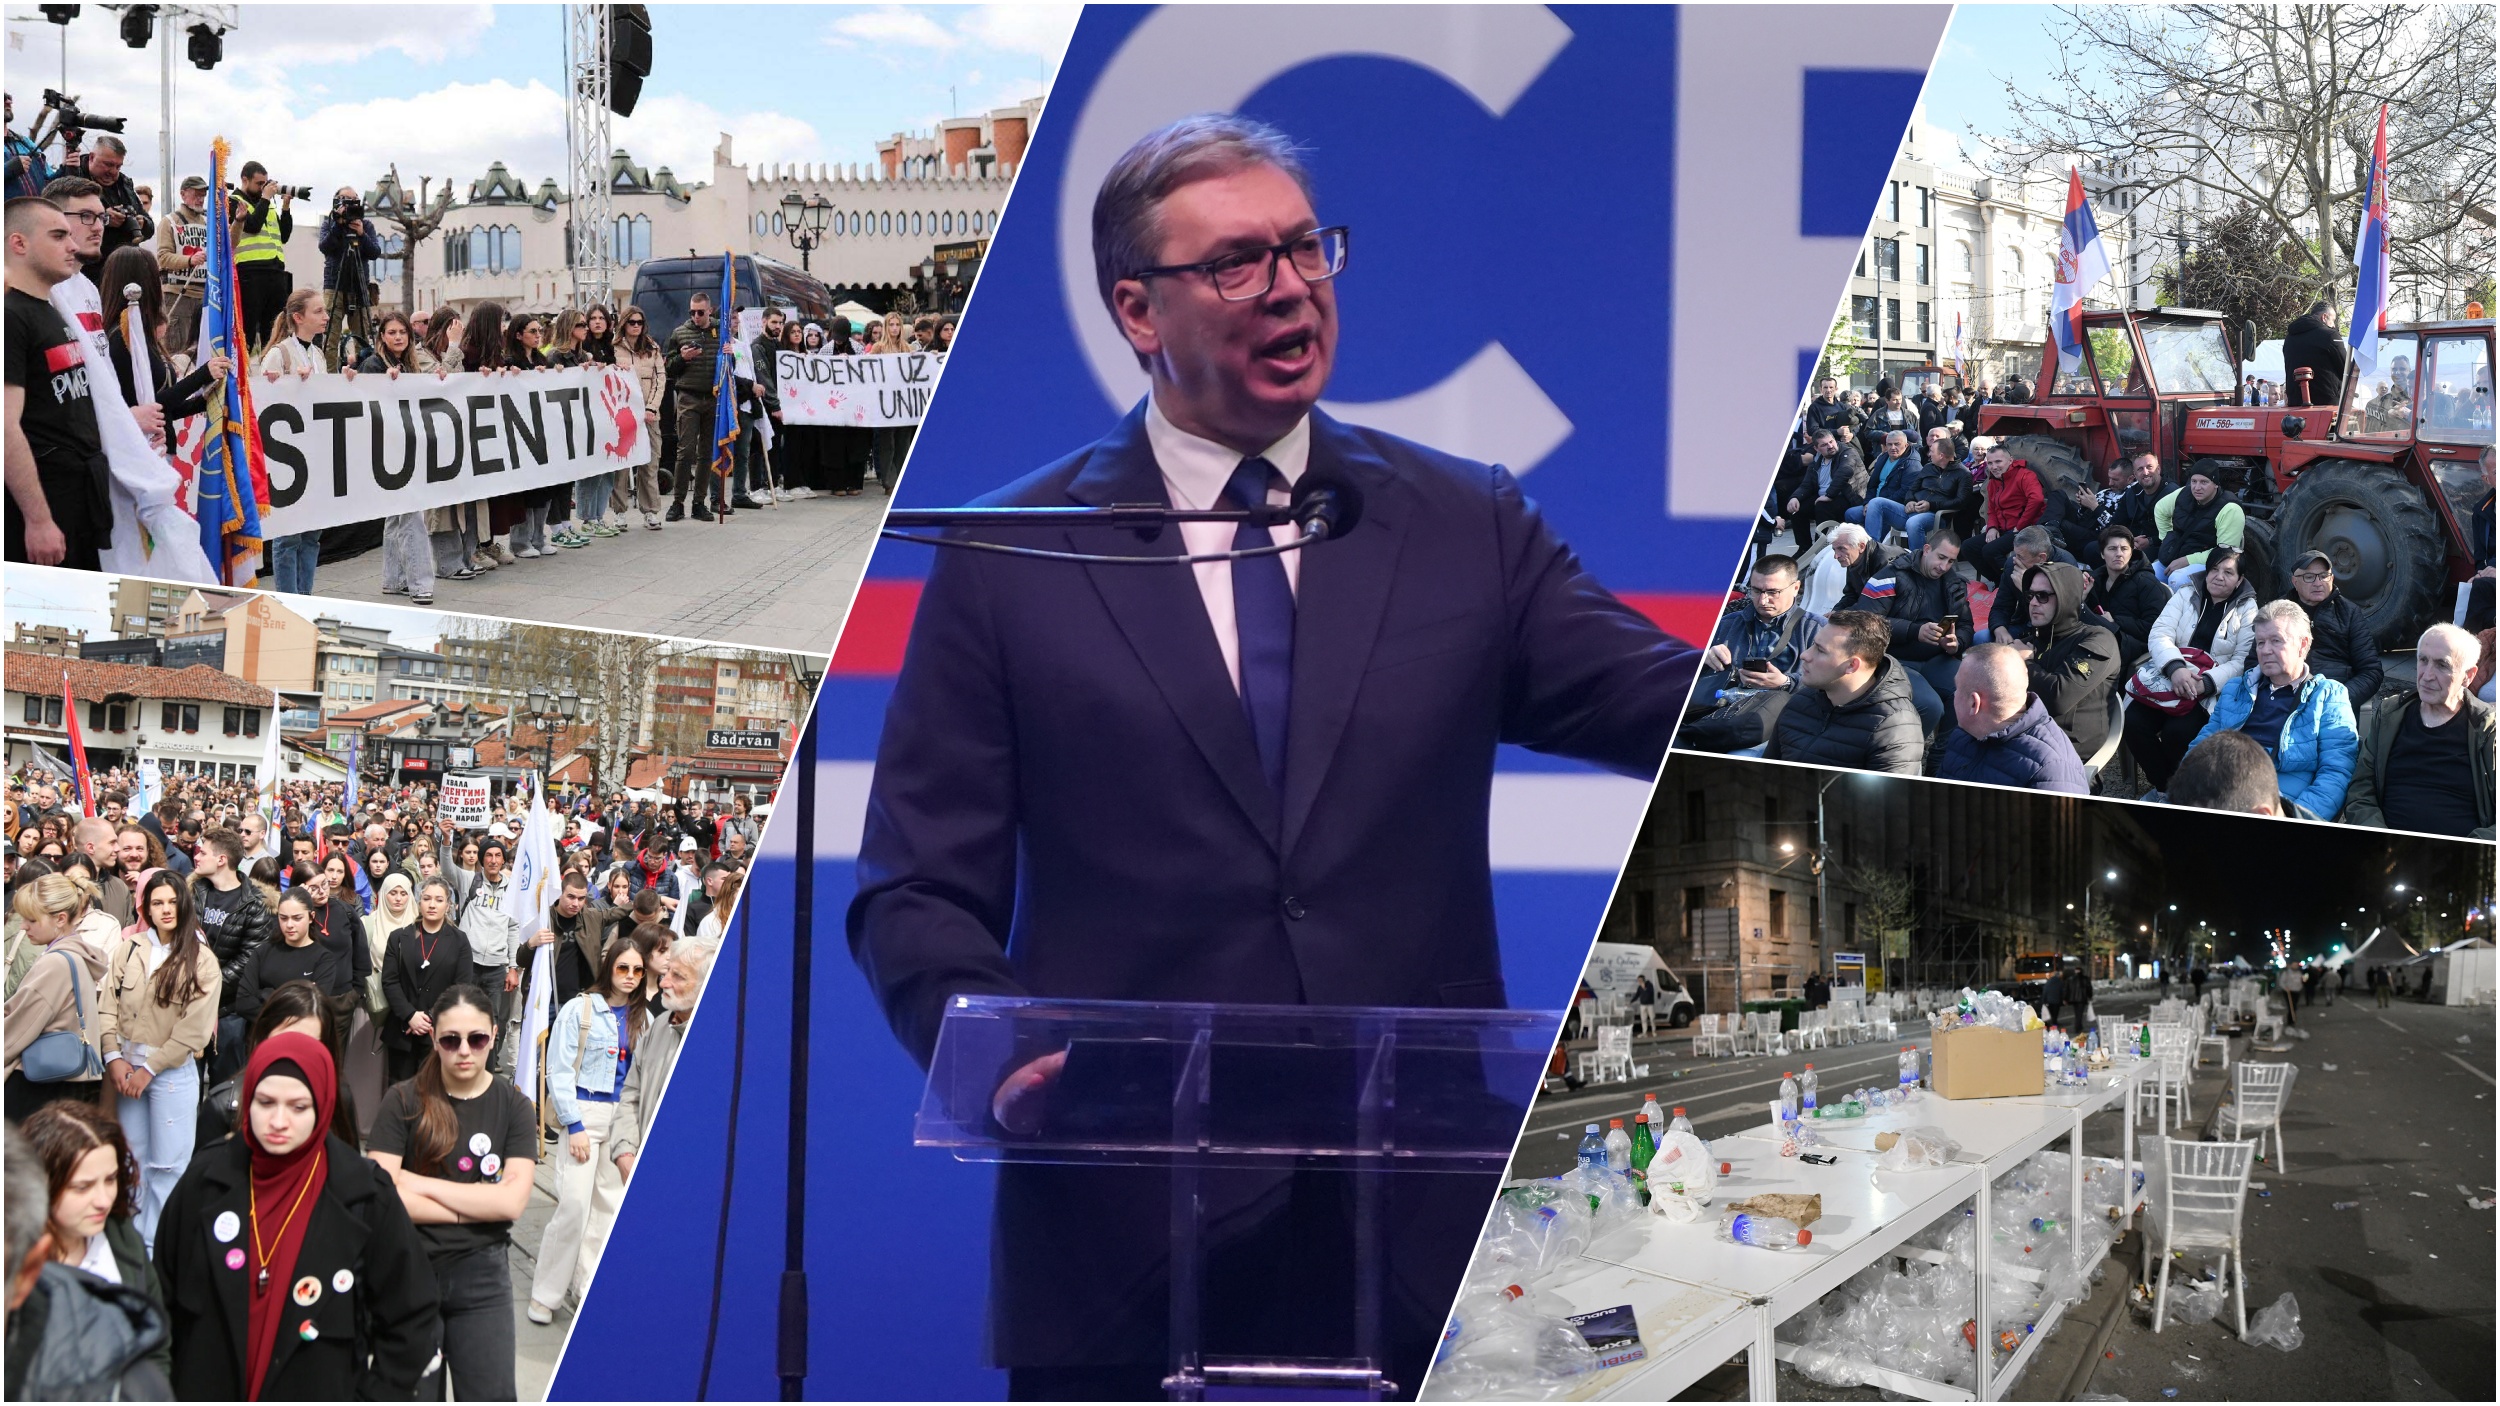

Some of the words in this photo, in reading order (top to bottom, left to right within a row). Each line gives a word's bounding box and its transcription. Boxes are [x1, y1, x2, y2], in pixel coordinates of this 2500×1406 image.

[779, 353, 886, 385] STUDENTI
[897, 354, 930, 384] UZ
[258, 387, 596, 508] STUDENTI
[711, 733, 772, 747] Šadrvan
[446, 779, 468, 788] ХВАЛА
[449, 796, 460, 805] СЕ
[464, 797, 486, 806] БОРЕ
[460, 806, 487, 814] ЗЕМЉУ
